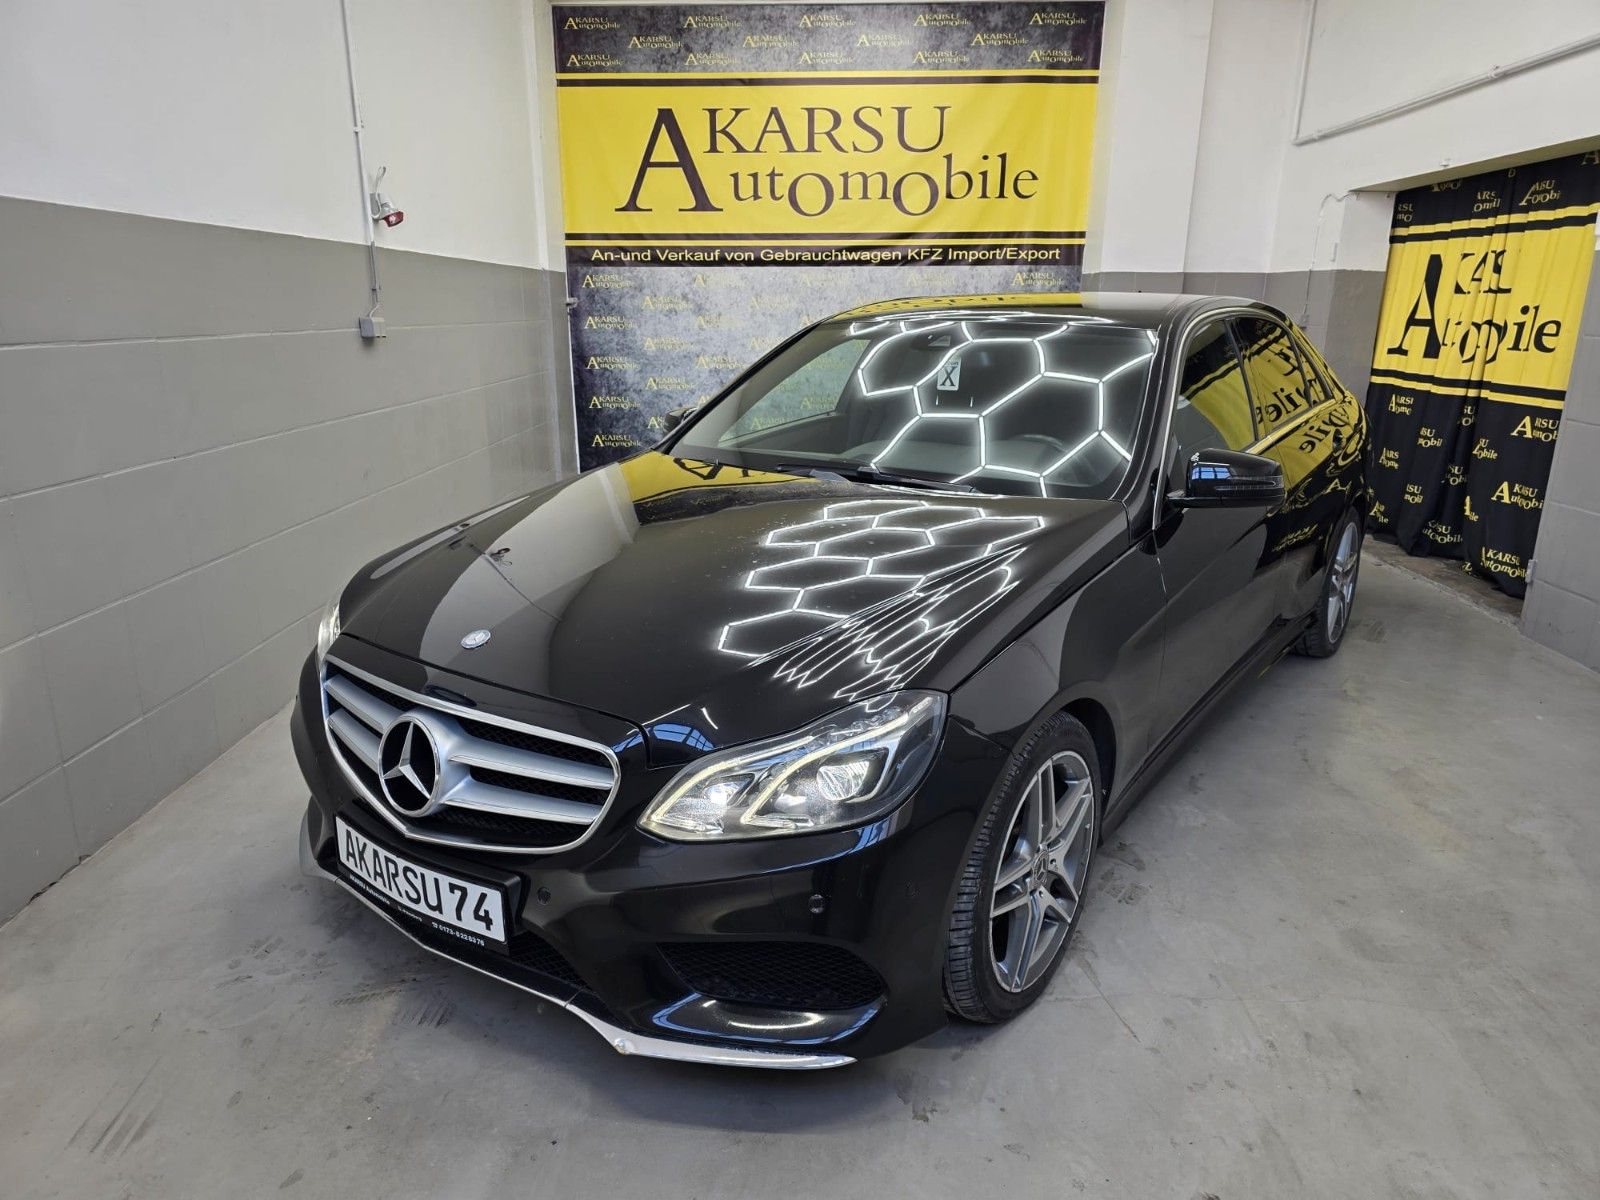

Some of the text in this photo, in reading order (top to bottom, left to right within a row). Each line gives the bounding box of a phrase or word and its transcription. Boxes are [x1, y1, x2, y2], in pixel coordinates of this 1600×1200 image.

[615, 106, 951, 212] AKARSU
[615, 150, 1040, 217] Automobile
[591, 247, 1061, 263] An-und Verkauf von Gebrauchtwagen KFZ Import/Export
